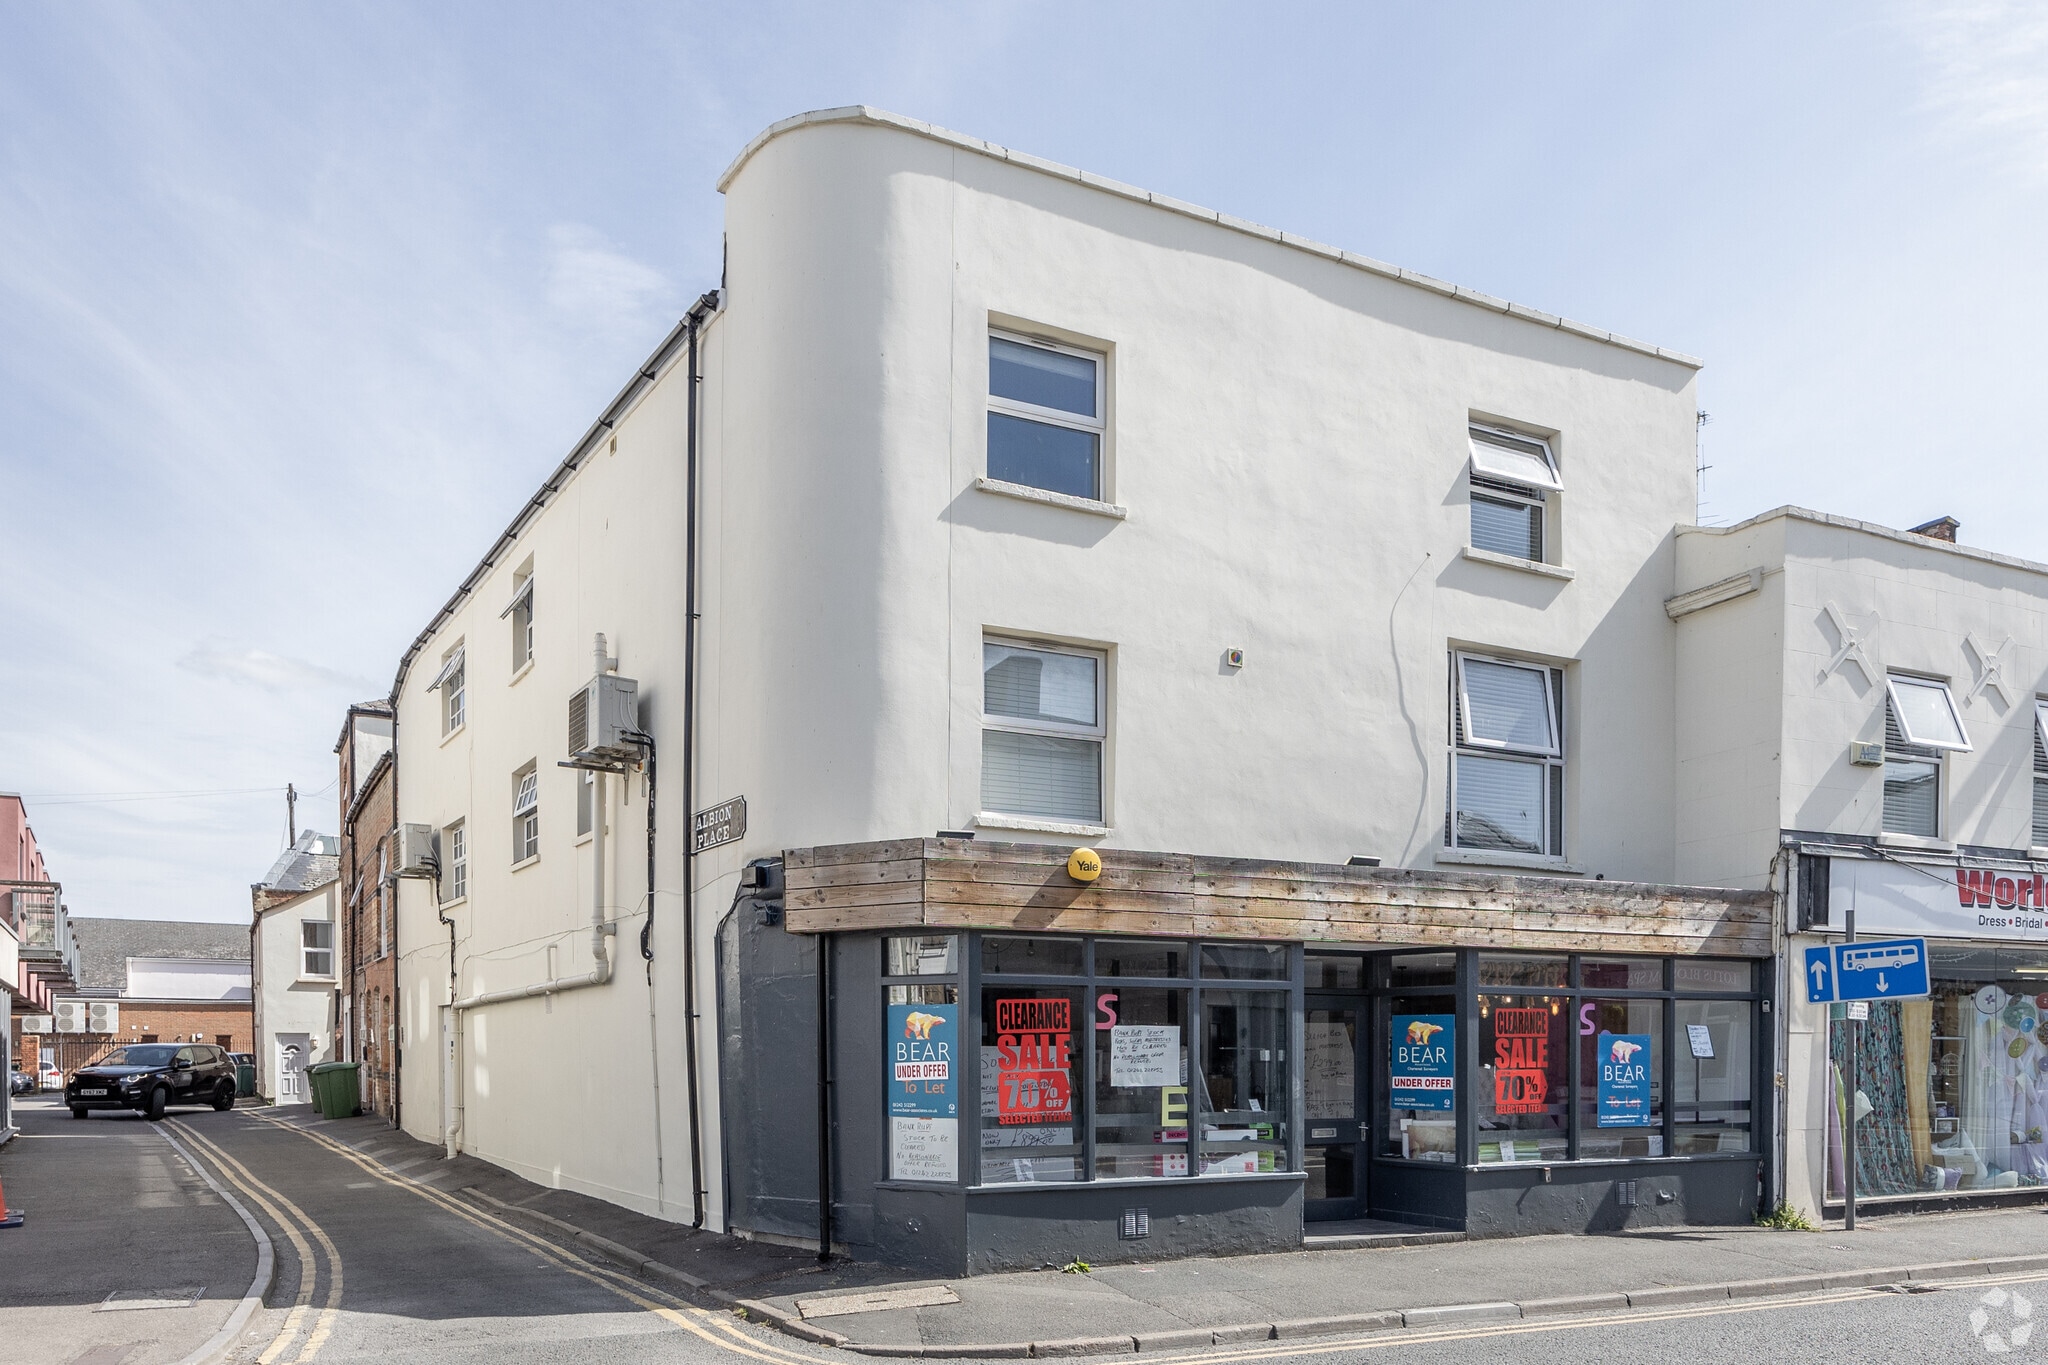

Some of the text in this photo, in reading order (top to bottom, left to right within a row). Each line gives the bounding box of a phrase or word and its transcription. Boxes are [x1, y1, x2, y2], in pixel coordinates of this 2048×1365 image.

[696, 805, 732, 831] ALBION
[697, 825, 730, 849] PLACE
[1077, 860, 1098, 872] Yale
[1956, 869, 2048, 912] Worl
[1978, 914, 2043, 929] Dress Bridal
[1000, 1002, 1068, 1030] CLEARANCE
[1095, 993, 1118, 1030] S
[1498, 1011, 1546, 1034] CLEARANCE
[1580, 1003, 1595, 1036] S
[896, 1042, 951, 1061] BEAR
[997, 1034, 1072, 1071] SALE
[1398, 1046, 1447, 1064] BEAR
[1495, 1038, 1548, 1068] SALE
[896, 1063, 947, 1078] UNDER OFFER
[1604, 1065, 1645, 1081] BEAR
[903, 1080, 945, 1094] To Let
[1003, 1078, 1058, 1109] 70%
[1394, 1078, 1451, 1088] UNDER OFFER
[1500, 1076, 1538, 1101] 70%
[1045, 1099, 1064, 1108] OFF
[1162, 1086, 1188, 1127] E
[1495, 1104, 1527, 1114] SELECTED
[998, 1113, 1042, 1125] SELECTED
